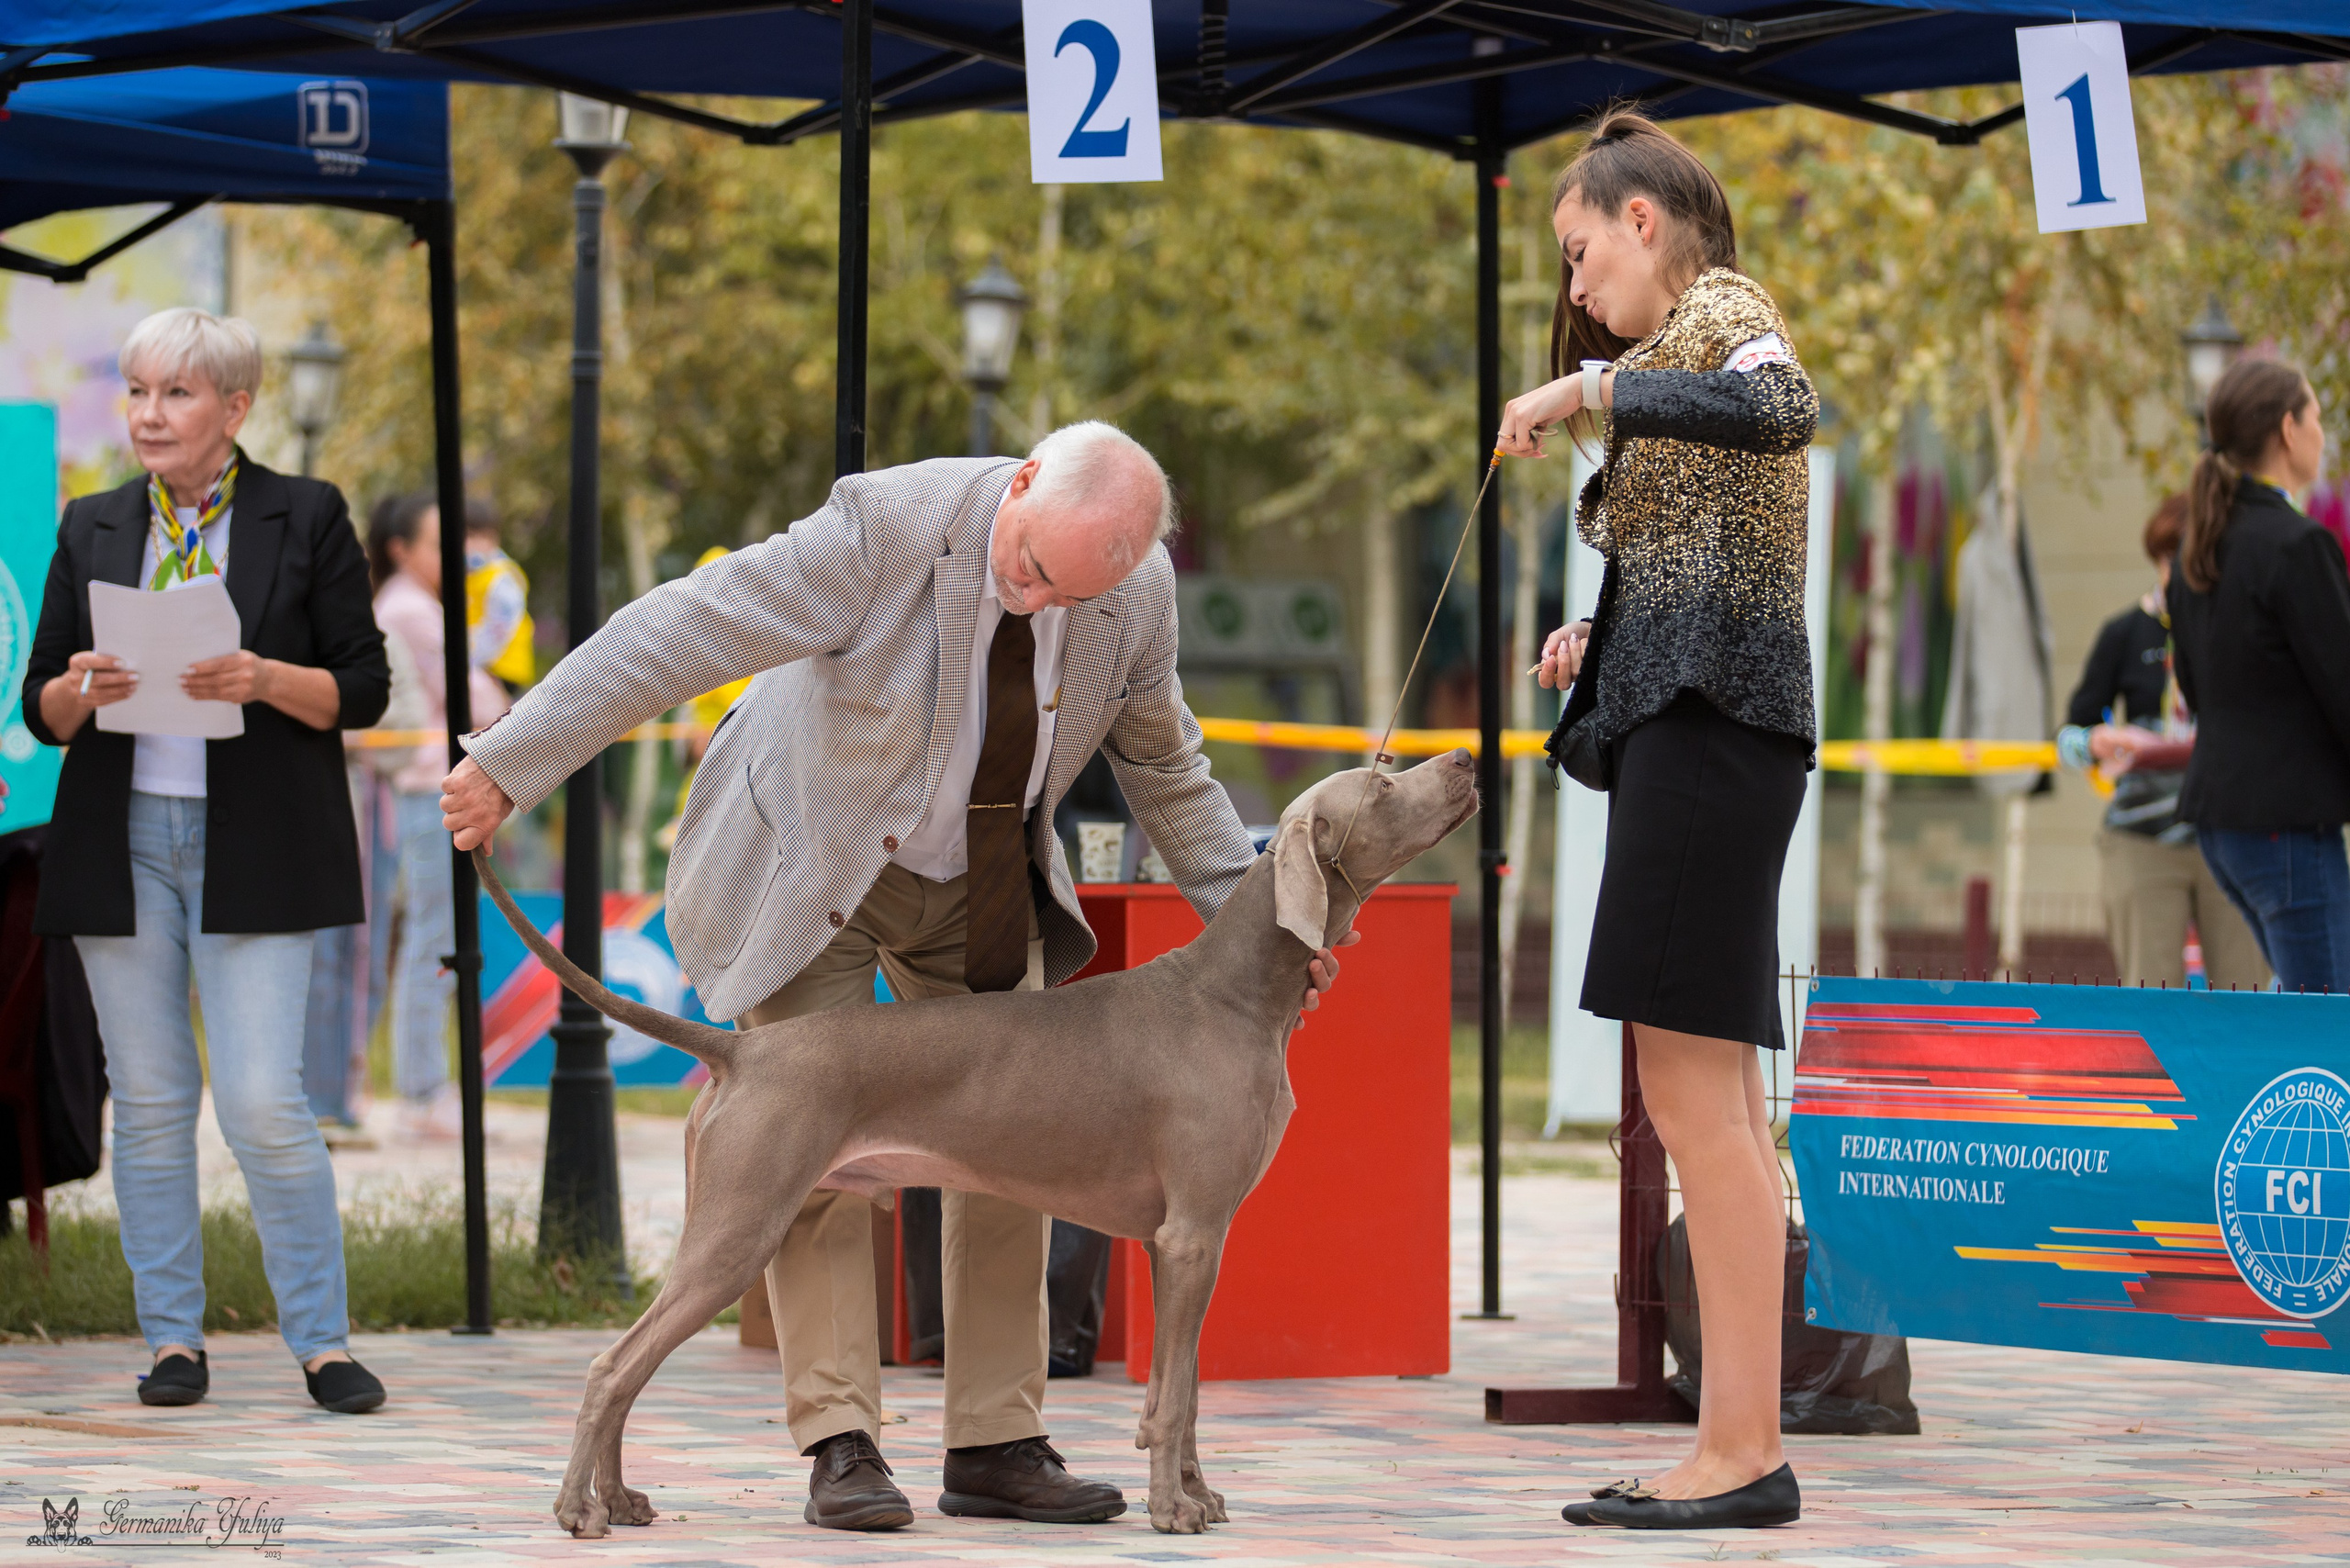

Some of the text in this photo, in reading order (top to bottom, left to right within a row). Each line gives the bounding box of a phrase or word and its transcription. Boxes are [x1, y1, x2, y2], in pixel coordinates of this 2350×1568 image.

[1054, 18, 1130, 158] 2
[2054, 72, 2117, 207] 1
[2233, 1081, 2346, 1155] CYNOLOGIQUE
[1839, 1170, 2006, 1204] INTERNATIONALE
[1840, 1134, 2109, 1177] FEDERATION CYNOLOGIQUE
[2266, 1170, 2322, 1215] FCI
[2223, 1160, 2283, 1300] FEDERATION
